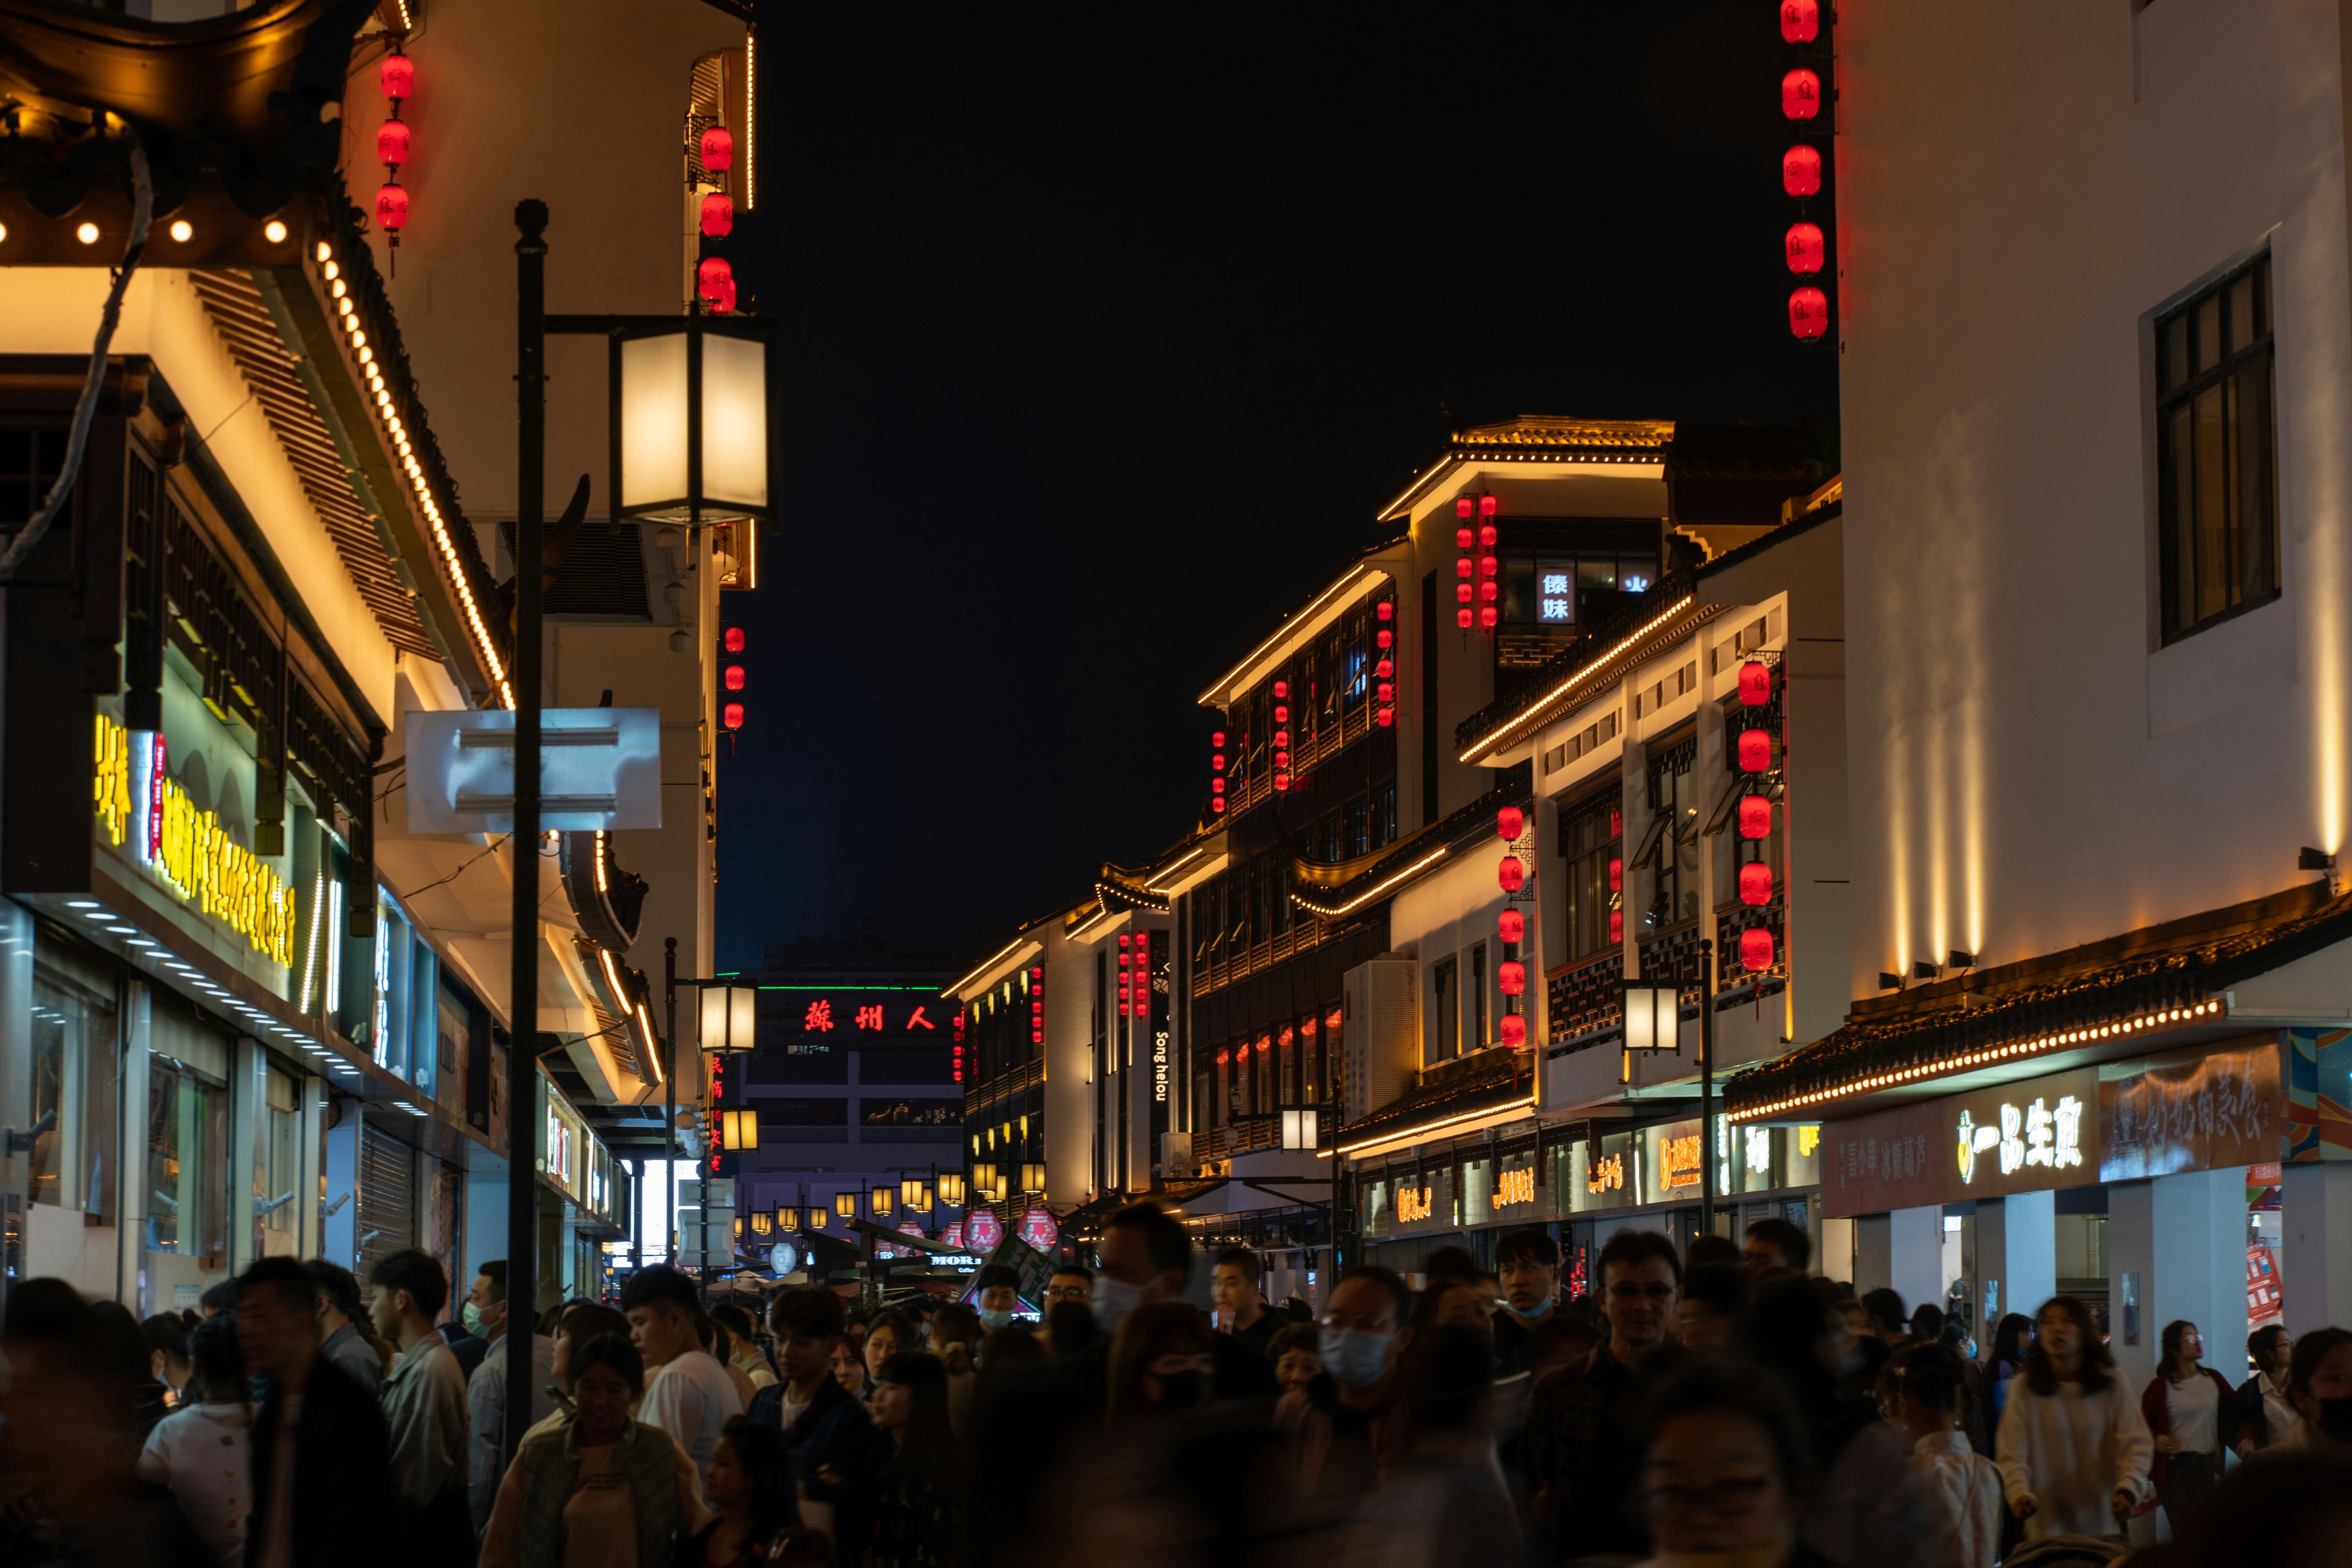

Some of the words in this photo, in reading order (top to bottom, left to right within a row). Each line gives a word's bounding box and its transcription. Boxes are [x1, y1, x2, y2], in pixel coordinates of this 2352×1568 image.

[1543, 574, 1568, 619] 傣妹
[804, 999, 936, 1032] 蘇州人
[1154, 1032, 1169, 1062] Song
[1973, 1094, 2082, 1174] 一品生煎
